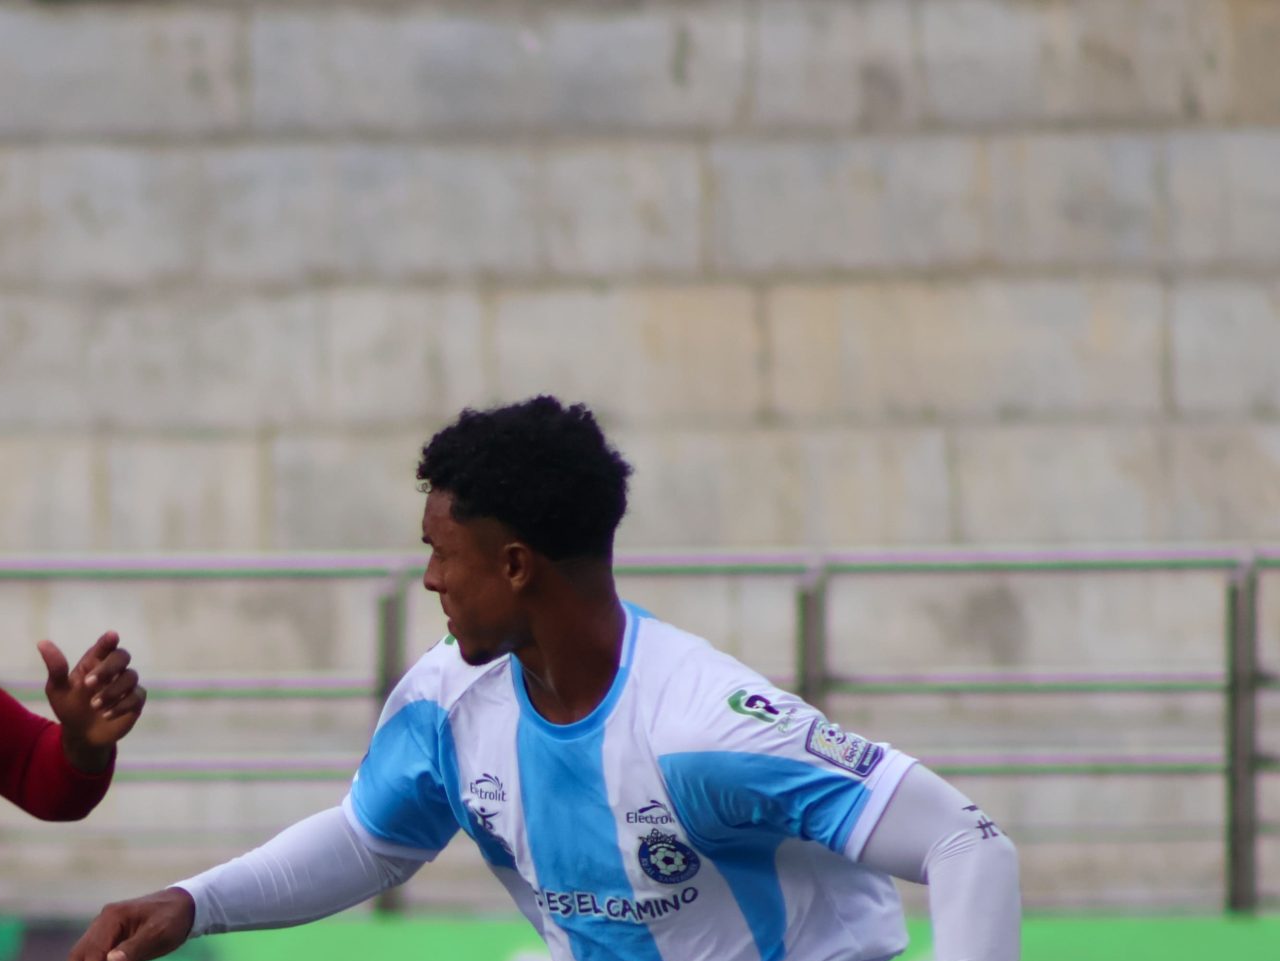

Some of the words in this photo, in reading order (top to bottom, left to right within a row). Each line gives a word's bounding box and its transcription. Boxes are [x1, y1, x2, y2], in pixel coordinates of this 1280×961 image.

[545, 890, 573, 916] ES
[576, 892, 604, 915] EL
[606, 886, 699, 921] CAMINO
